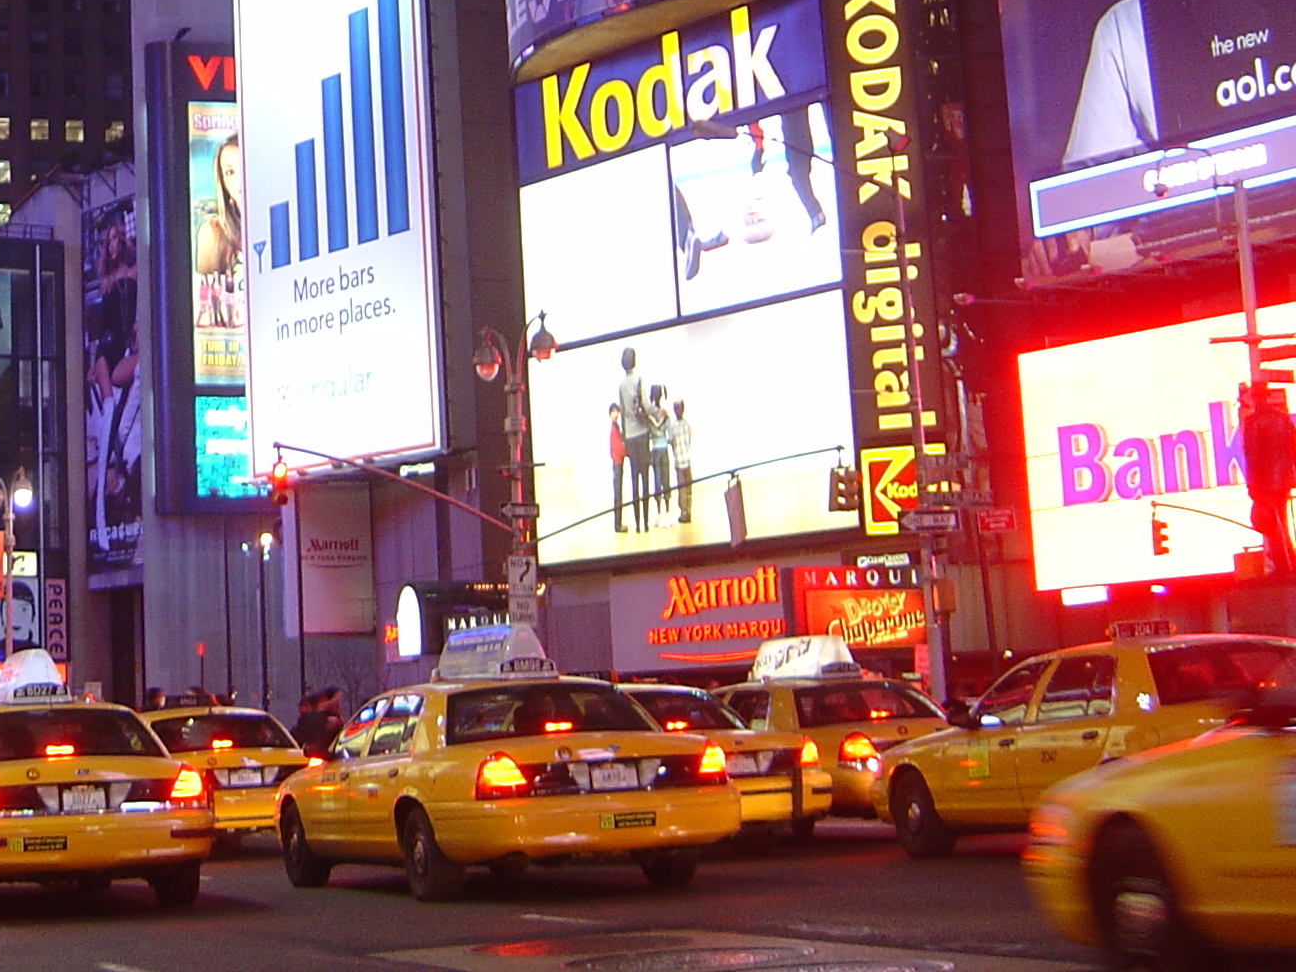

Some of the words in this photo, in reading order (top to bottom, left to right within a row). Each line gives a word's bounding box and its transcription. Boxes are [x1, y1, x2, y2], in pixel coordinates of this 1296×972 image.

[1211, 34, 1235, 58] the
[1236, 28, 1269, 50] new
[541, 5, 786, 169] Kodak
[293, 275, 335, 304] More
[339, 265, 375, 291] bars
[277, 317, 290, 341] in
[293, 311, 334, 337] more
[339, 296, 396, 335] places.
[1057, 400, 1248, 507] Bank
[886, 480, 918, 500] Kod
[307, 538, 359, 553] Marriott
[661, 564, 779, 621] Marriott
[804, 569, 918, 587] MARQUI
[47, 582, 64, 655] PEACE
[447, 612, 510, 630] MARQUI
[648, 627, 681, 645] NEW
[683, 622, 723, 643] YORK
[724, 618, 786, 639] MARQU
